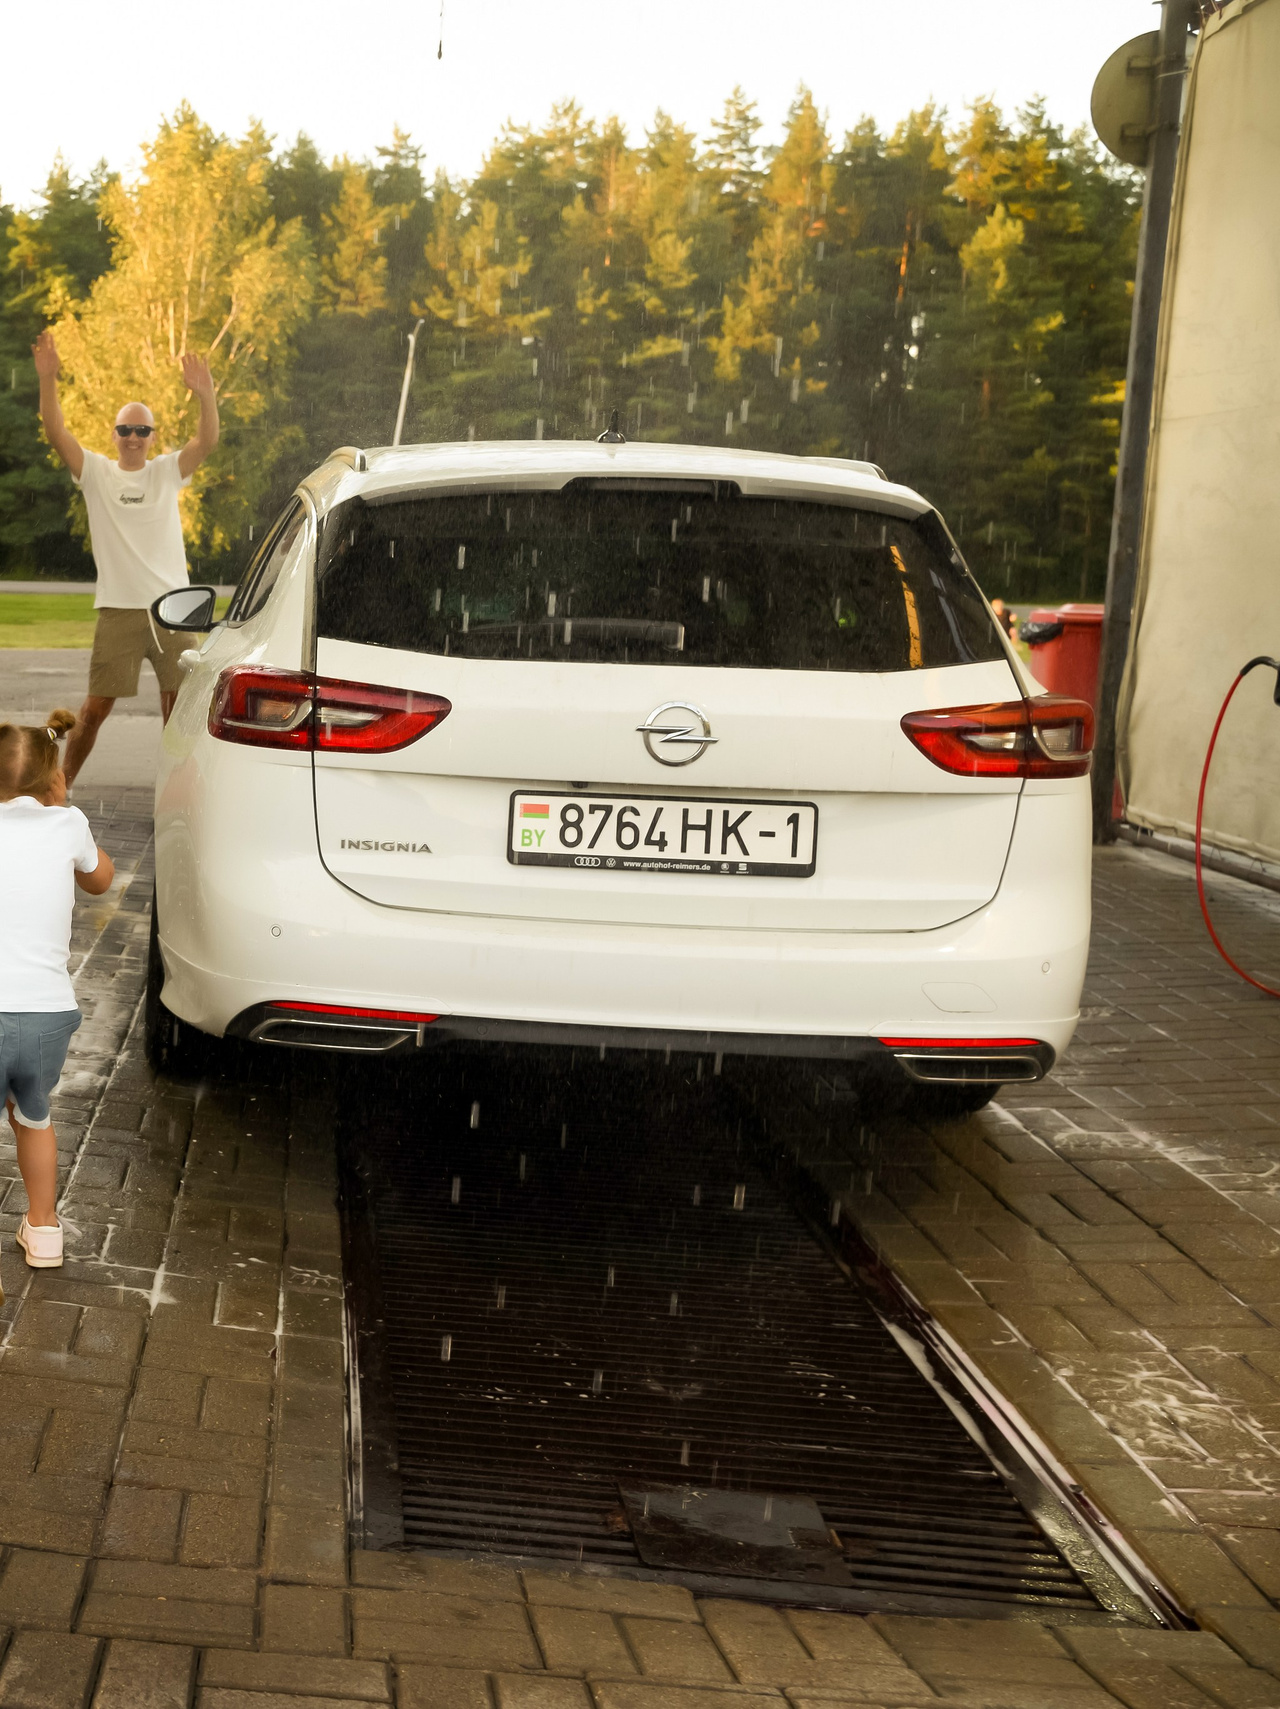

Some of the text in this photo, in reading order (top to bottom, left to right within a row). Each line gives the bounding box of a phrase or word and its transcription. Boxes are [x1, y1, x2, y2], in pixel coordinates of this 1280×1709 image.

[558, 803, 669, 853] 8764
[520, 829, 546, 847] BY
[340, 839, 433, 854] INSIGNIA
[623, 861, 711, 871] www.autohof-reimers.de
